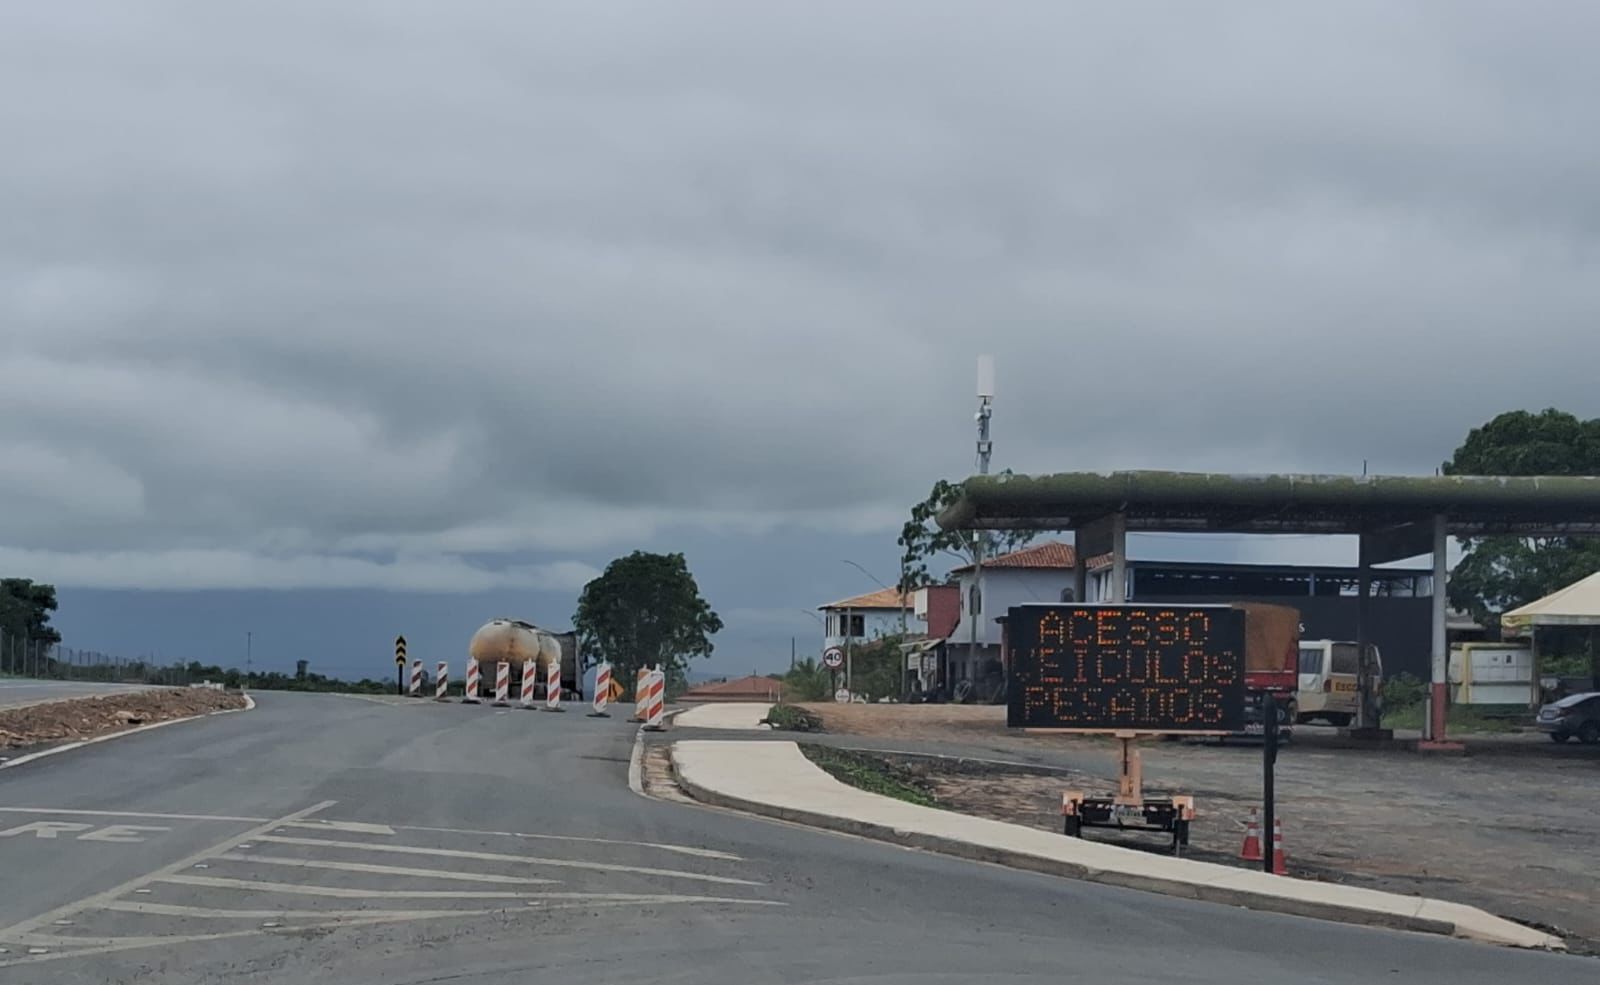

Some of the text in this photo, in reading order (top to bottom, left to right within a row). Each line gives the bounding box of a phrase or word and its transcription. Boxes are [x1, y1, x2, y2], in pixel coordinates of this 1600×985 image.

[1040, 610, 1211, 645] ACESSO
[825, 652, 841, 662] 40
[1025, 686, 1224, 724] PESADOS
[0, 820, 173, 843] RE
